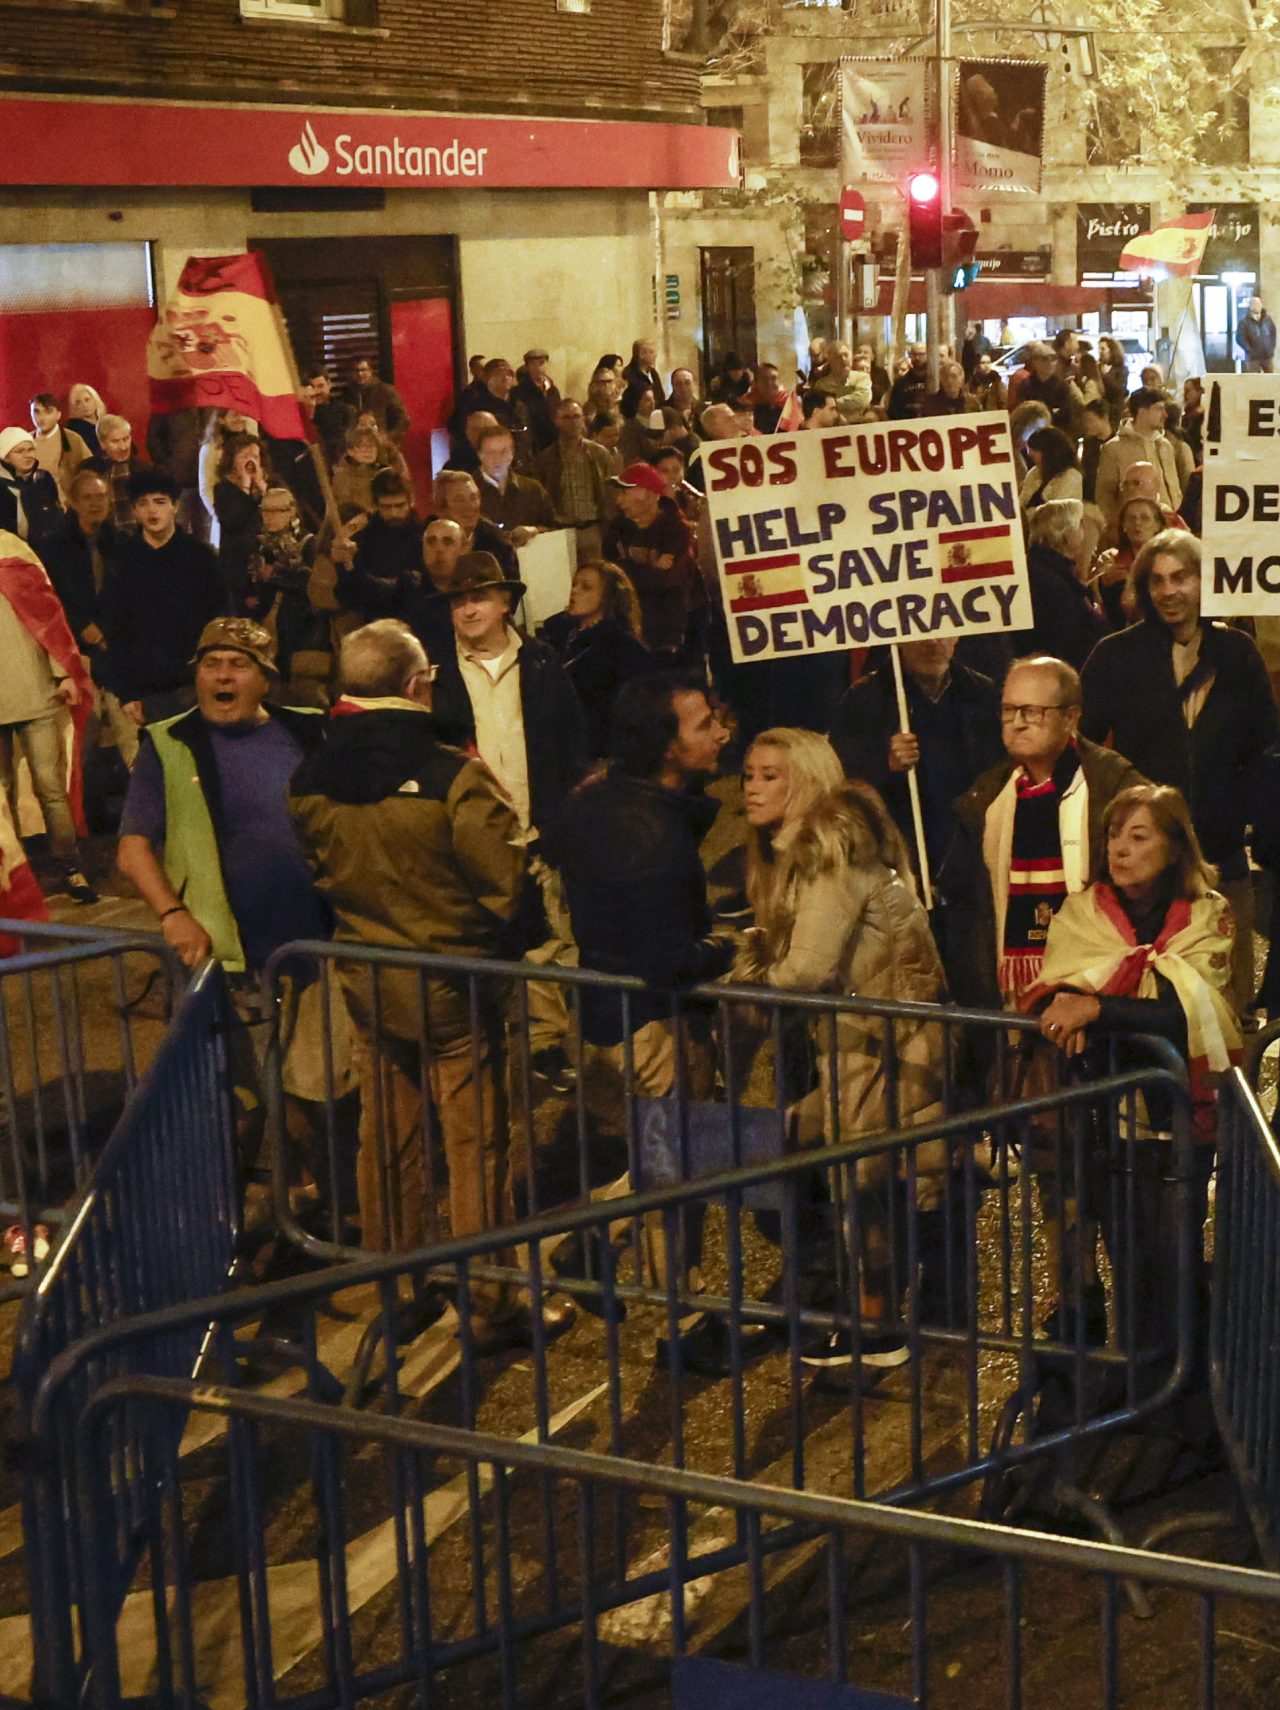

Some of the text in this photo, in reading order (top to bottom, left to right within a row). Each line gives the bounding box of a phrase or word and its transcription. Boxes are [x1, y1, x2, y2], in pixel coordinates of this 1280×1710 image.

[335, 134, 488, 176] Santander
[857, 131, 913, 145] Vividero
[965, 160, 1014, 179] Momo
[708, 422, 1011, 492] SOS EUROPE
[716, 503, 846, 558] HELP
[869, 482, 1016, 535] SPAIN
[808, 540, 933, 594] SAVE
[735, 584, 1019, 656] DEMOCRACY
